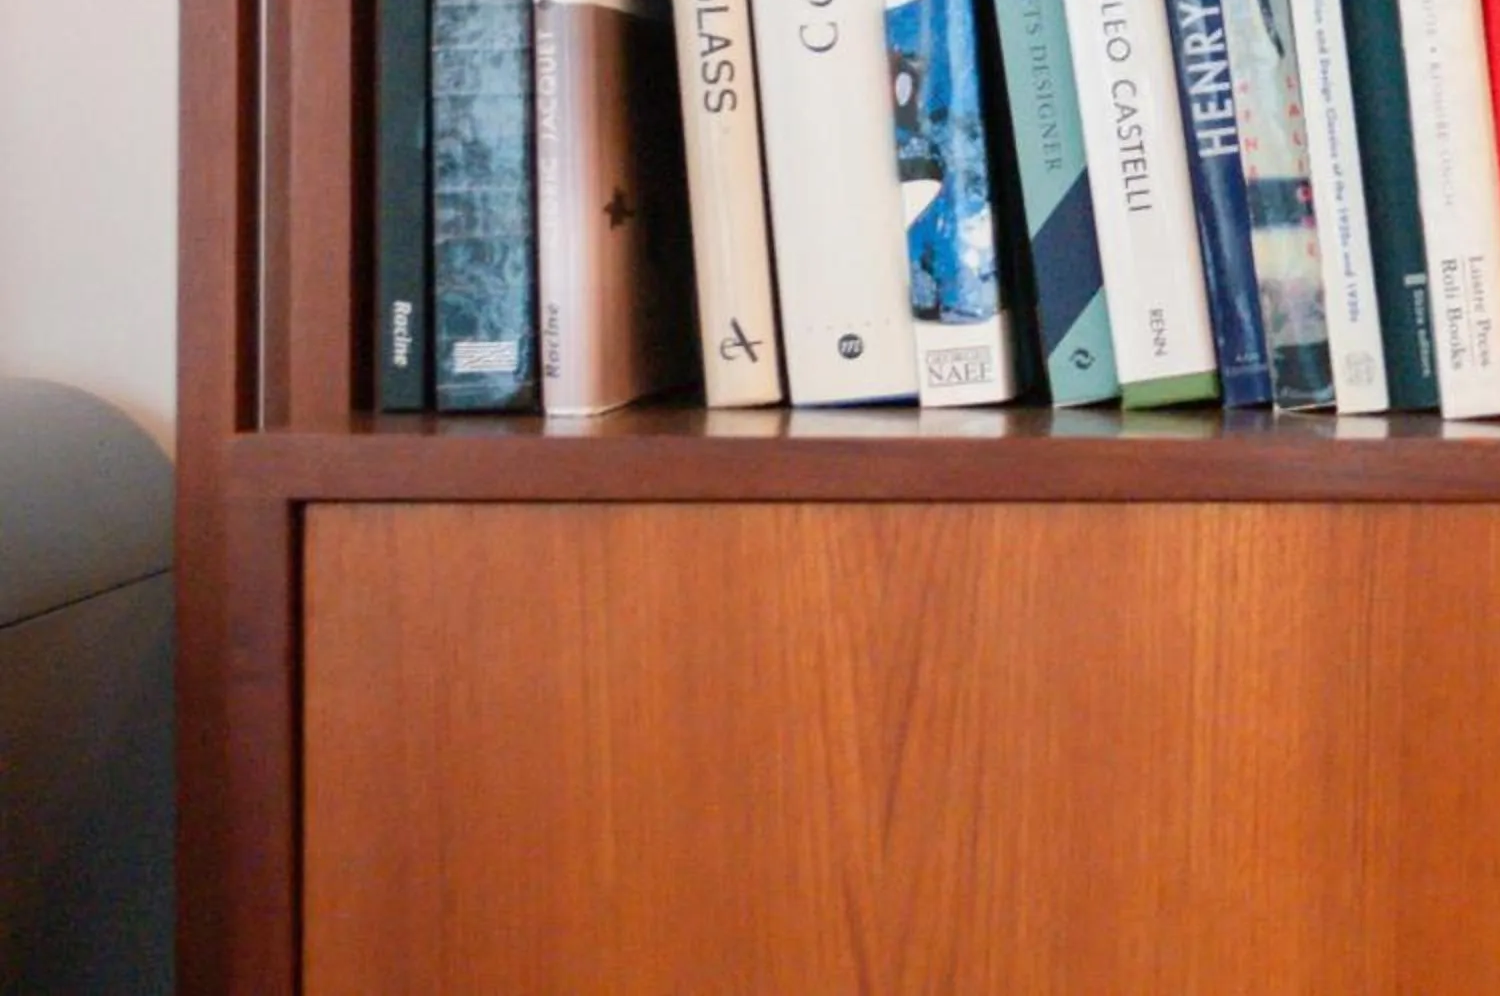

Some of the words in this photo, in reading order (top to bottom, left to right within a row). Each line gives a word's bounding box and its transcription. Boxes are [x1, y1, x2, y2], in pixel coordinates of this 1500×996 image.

[1101, 2, 1132, 62] LEO
[1026, 41, 1064, 174] DESIGNER
[1177, 4, 1240, 158] HENRY
[1111, 79, 1153, 214] CASTELLI
[1441, 258, 1463, 300] Roli
[1468, 255, 1490, 314] Lustre
[1149, 308, 1167, 357] RENN
[1446, 307, 1467, 370] Books
[1476, 318, 1495, 368] Press
